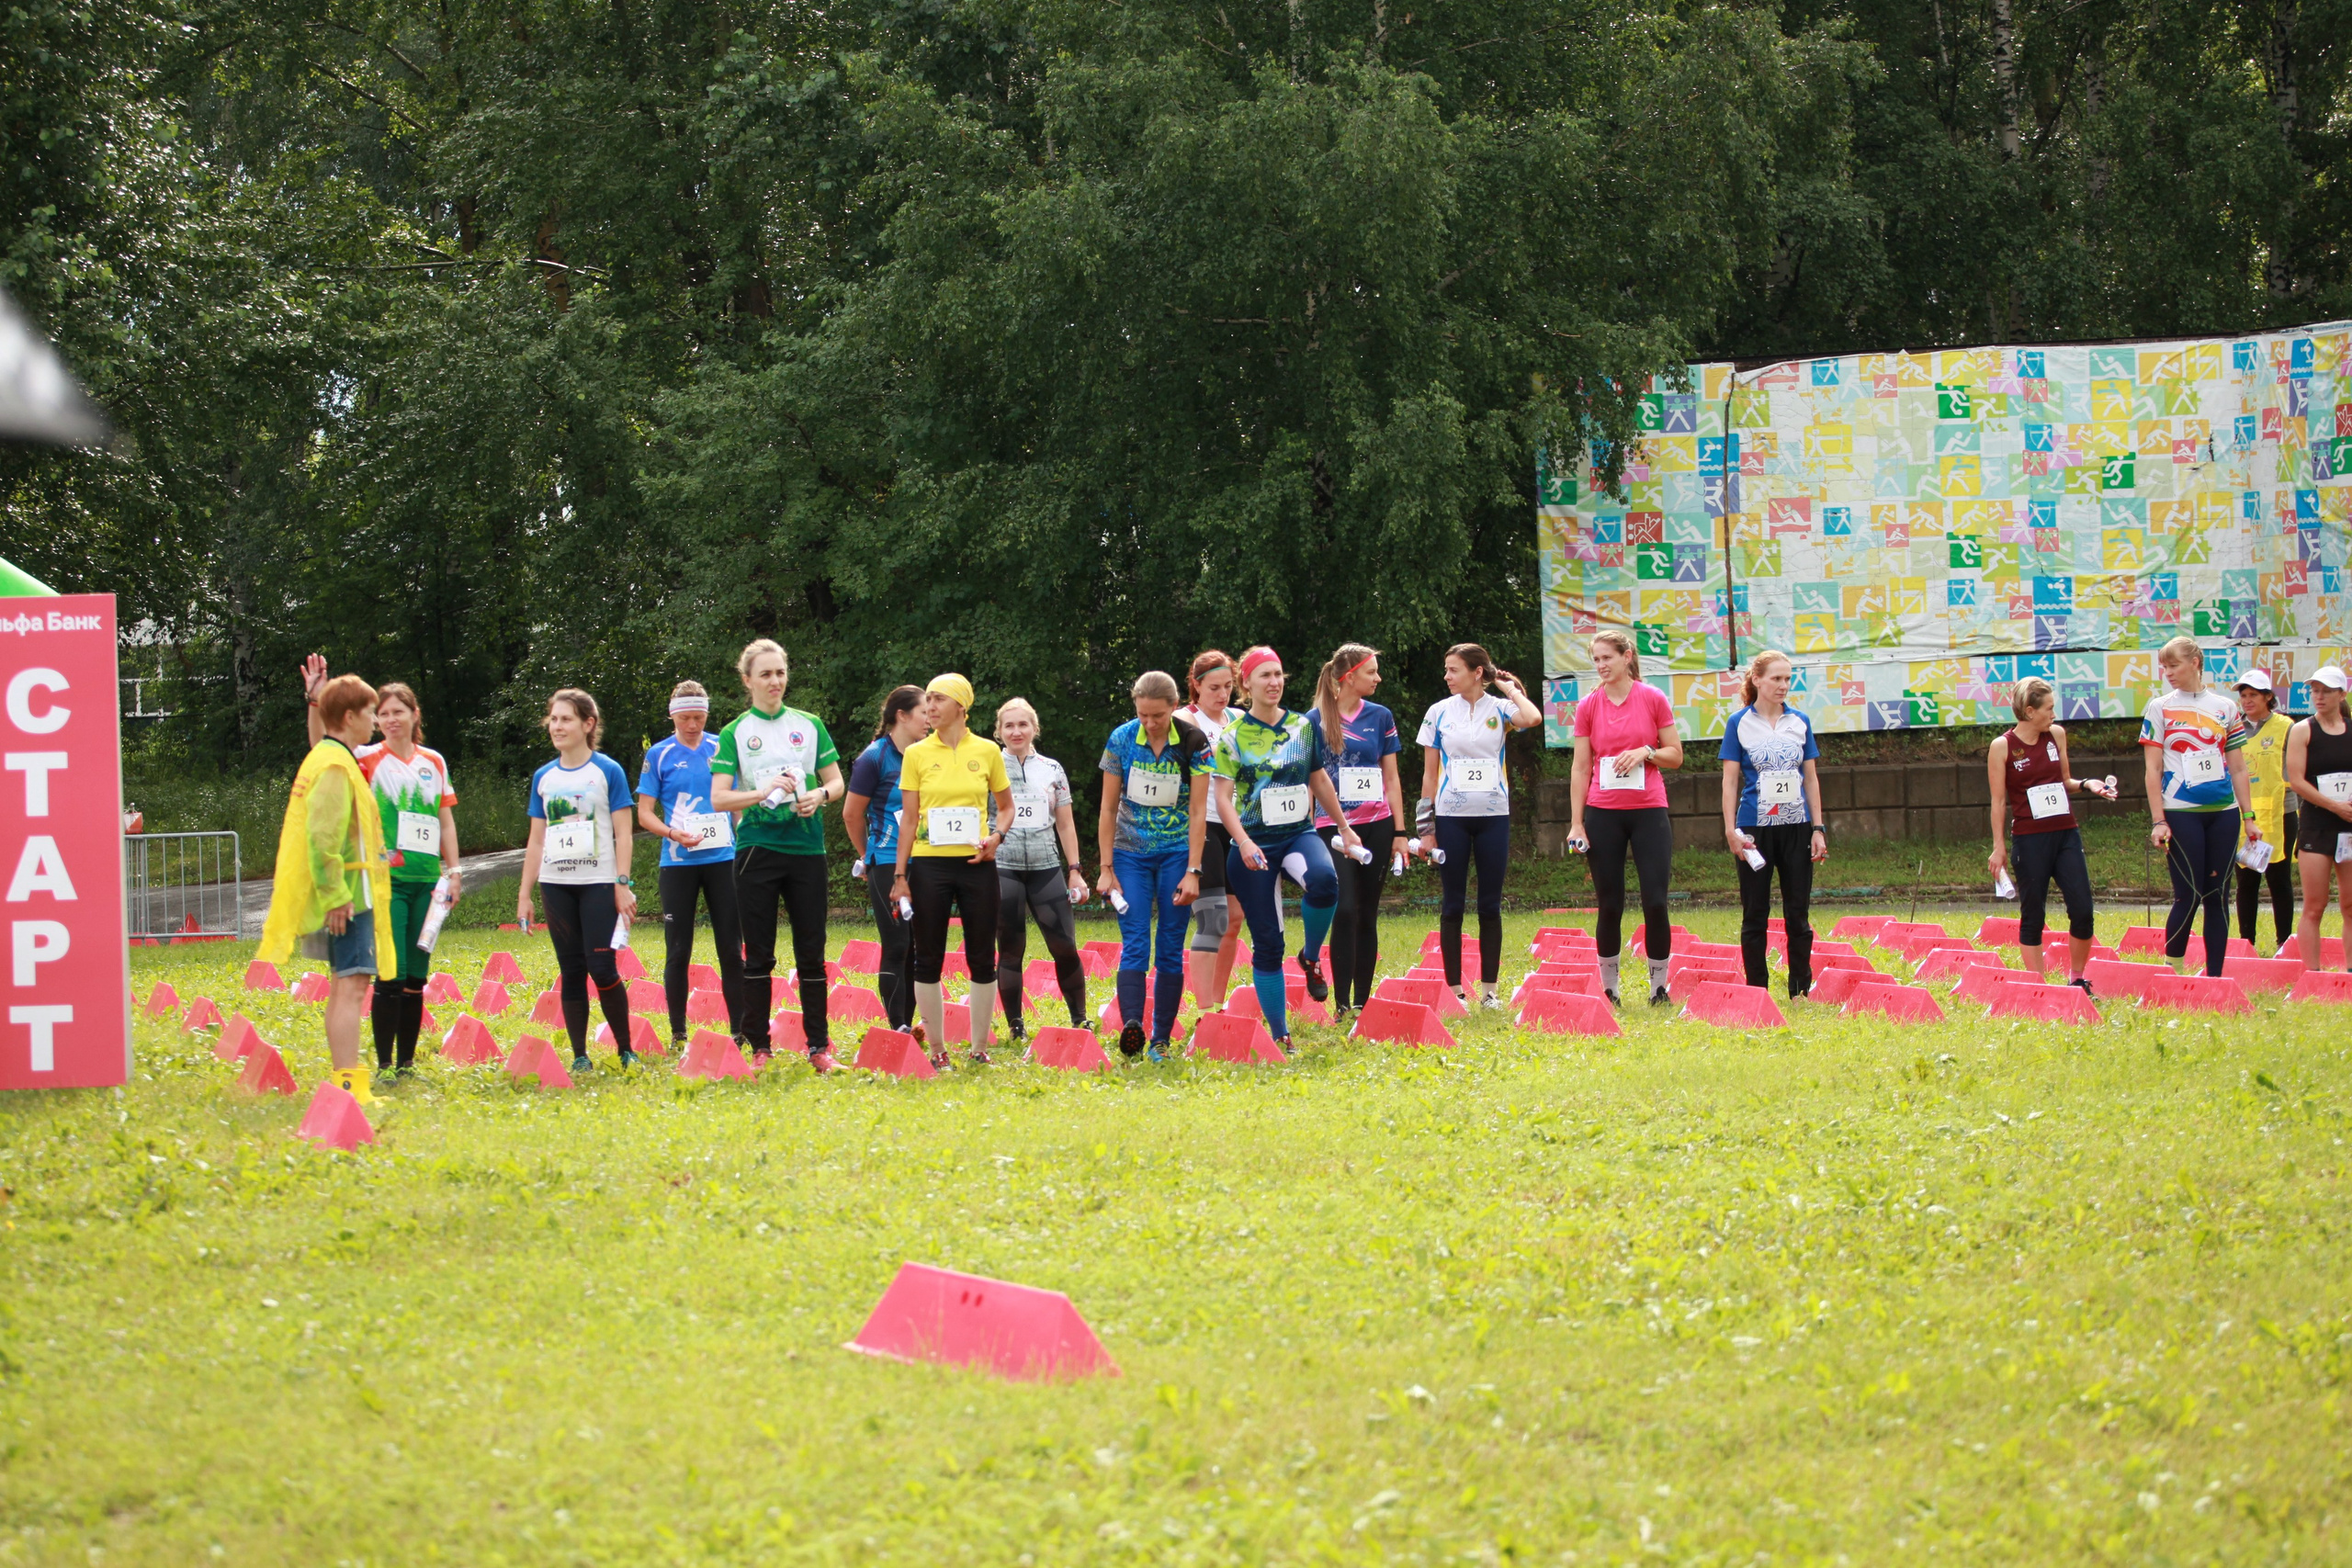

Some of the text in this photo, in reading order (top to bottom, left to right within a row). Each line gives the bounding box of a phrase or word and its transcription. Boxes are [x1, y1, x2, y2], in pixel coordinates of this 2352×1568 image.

[0, 612, 102, 637] ьфа Банк
[2199, 760, 2211, 771] 18
[1467, 770, 1482, 781] 23
[1356, 779, 1371, 789] 24
[1776, 782, 1789, 793] 21
[2335, 782, 2346, 793] 17
[1144, 784, 1157, 796] 11
[1281, 800, 1295, 811] 10
[2044, 795, 2057, 806] 19
[1017, 807, 1033, 817] 26
[946, 820, 962, 831] 12
[416, 828, 430, 840] 15
[701, 827, 717, 838] 28
[559, 837, 573, 849] 14
[5, 668, 78, 1072] СТАРТ
